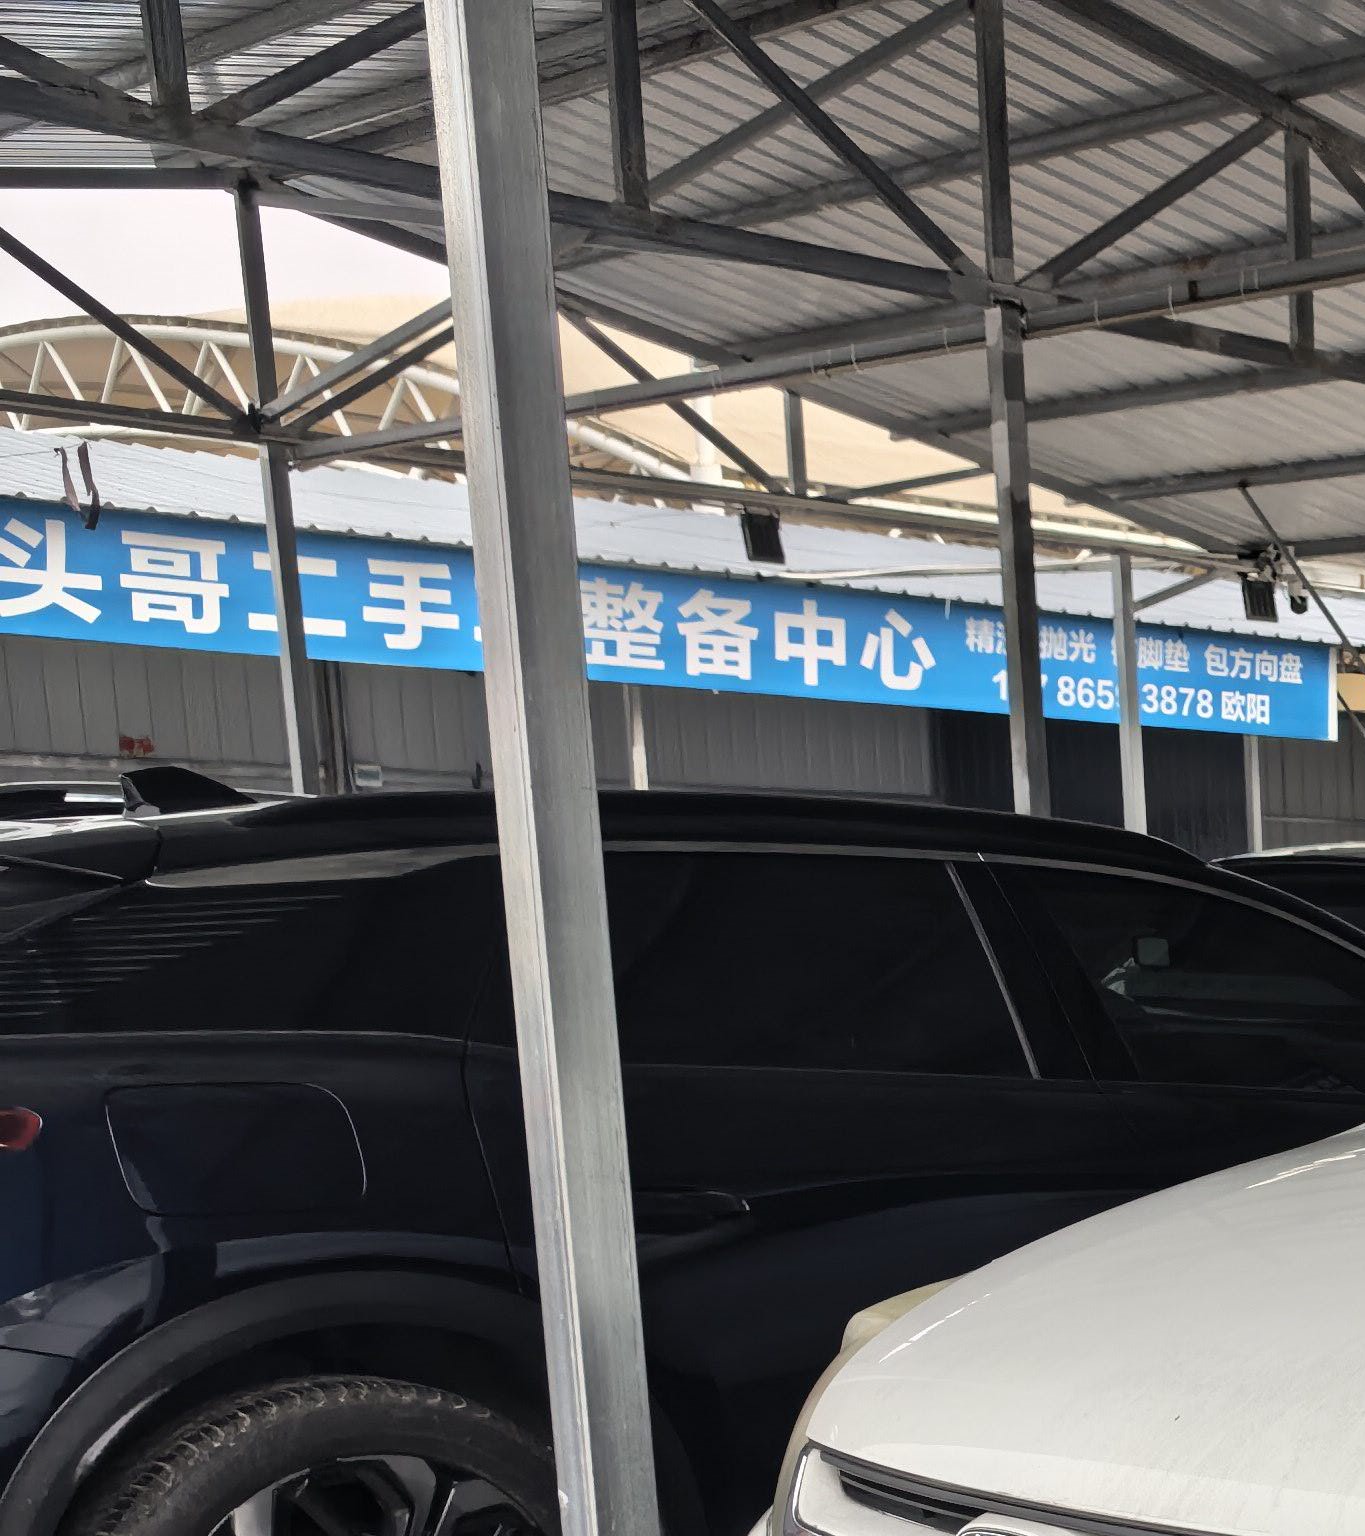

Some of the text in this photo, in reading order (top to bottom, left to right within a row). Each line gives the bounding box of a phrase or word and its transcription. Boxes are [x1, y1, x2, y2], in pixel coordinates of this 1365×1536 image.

[0, 518, 936, 692] 头哥二手整备中心
[1204, 643, 1303, 685] 包方向盘
[1057, 676, 1121, 712] 865
[1141, 683, 1214, 719] 3878
[1221, 690, 1271, 725] 欧阳
